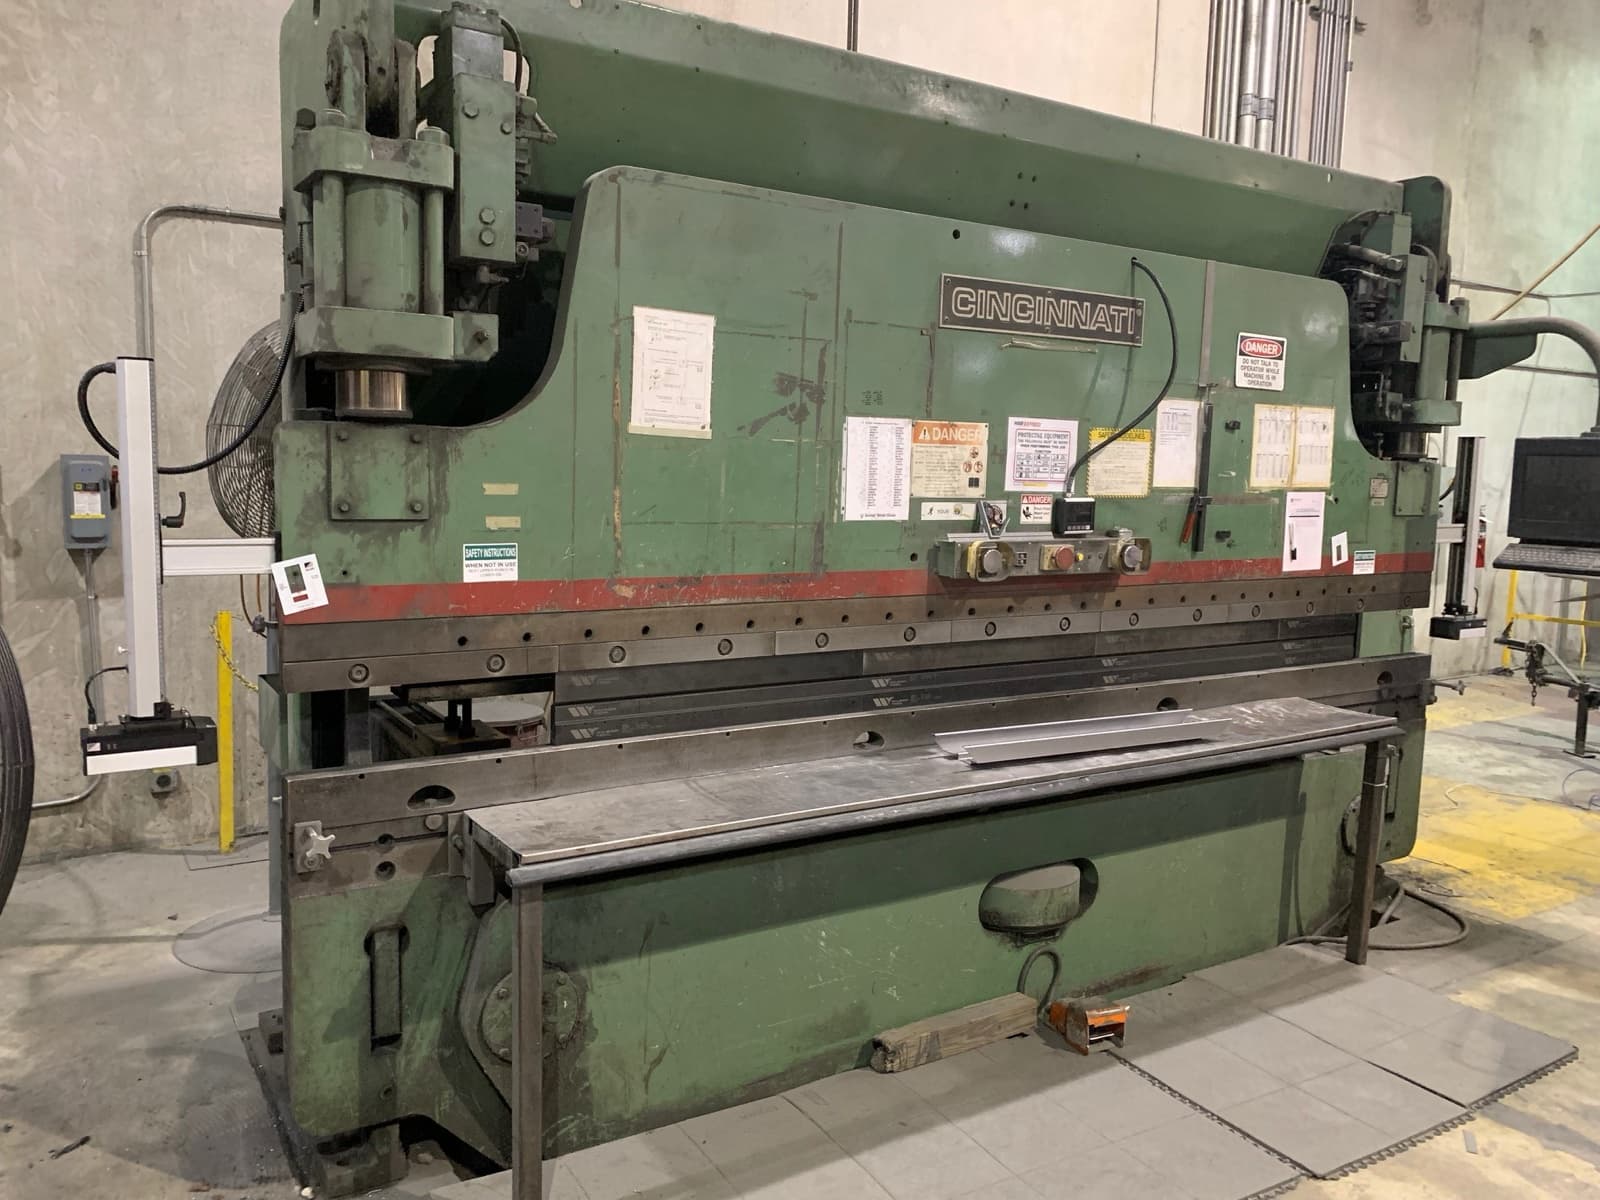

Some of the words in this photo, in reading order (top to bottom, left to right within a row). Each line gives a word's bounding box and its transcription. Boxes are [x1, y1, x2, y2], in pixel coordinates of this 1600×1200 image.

[952, 287, 1136, 334] CINCINNATI
[1245, 341, 1278, 354] DANGER
[1240, 365, 1264, 373] OPERATOR
[1244, 372, 1264, 380] MACHINE
[1247, 379, 1272, 387] OPERATION
[465, 548, 483, 558] SAFETY
[484, 548, 516, 557] INSTRUCTIONS
